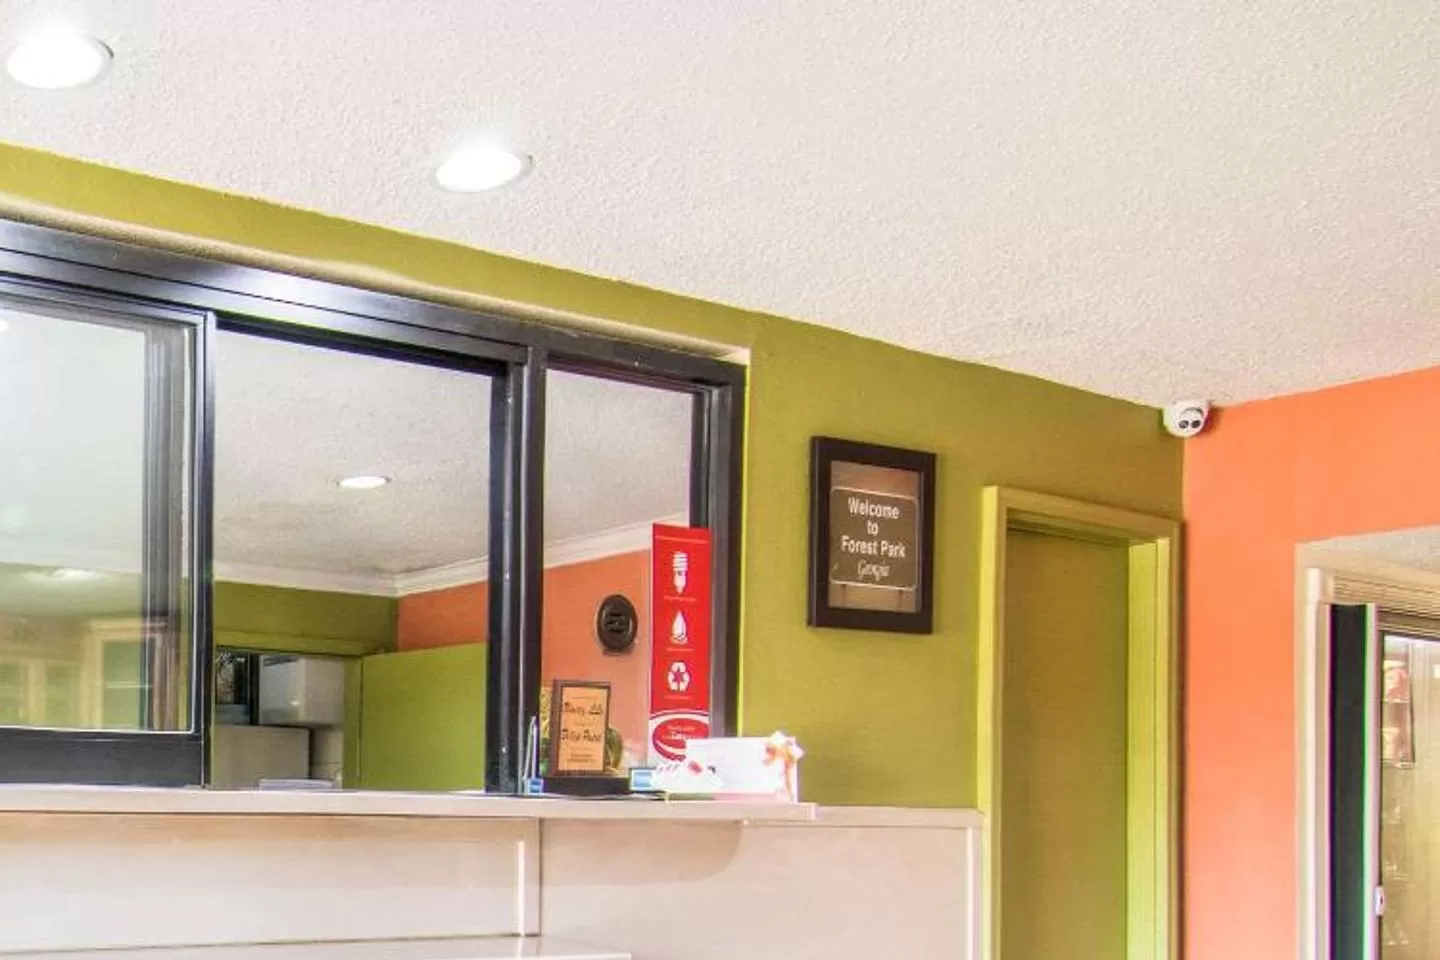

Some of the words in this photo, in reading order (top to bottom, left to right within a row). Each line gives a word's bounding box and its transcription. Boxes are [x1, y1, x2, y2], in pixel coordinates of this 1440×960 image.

[848, 497, 900, 520] Welcome
[867, 520, 879, 535] to
[841, 535, 878, 556] Forest
[880, 540, 906, 558] Park
